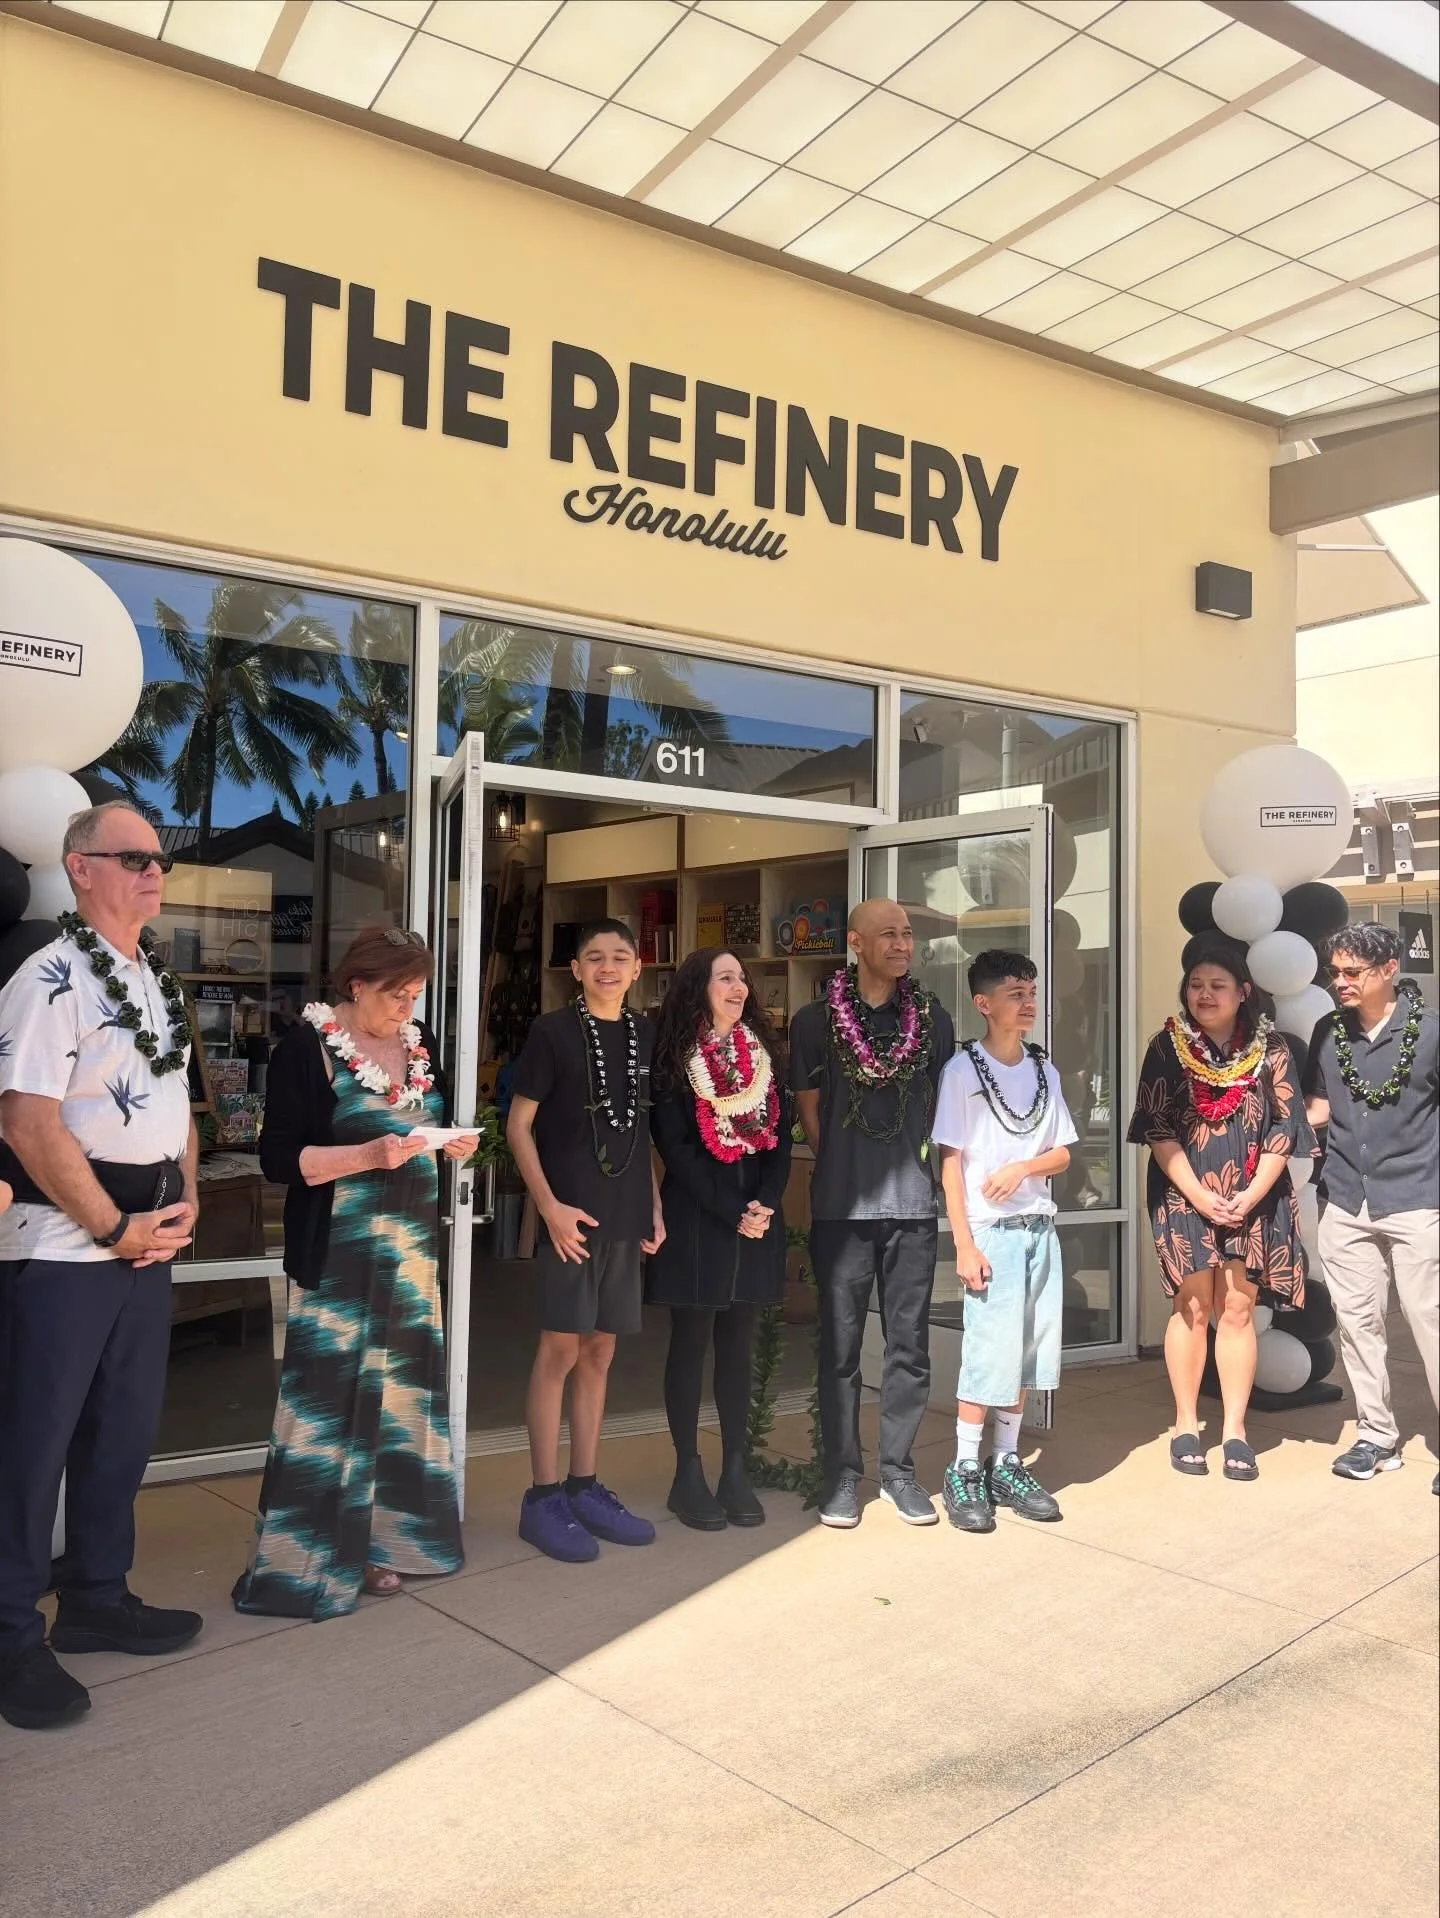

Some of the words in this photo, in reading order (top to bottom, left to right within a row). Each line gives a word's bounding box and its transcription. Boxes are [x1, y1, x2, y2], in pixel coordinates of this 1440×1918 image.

[257, 256, 511, 449] THE
[550, 340, 1019, 562] REFINERY
[563, 483, 788, 561] Honolulu
[0, 640, 76, 662] EFINERY
[656, 742, 705, 777] 611
[1265, 812, 1285, 820] THE
[1288, 811, 1334, 819] REFINERY
[796, 939, 834, 950] Pickleball
